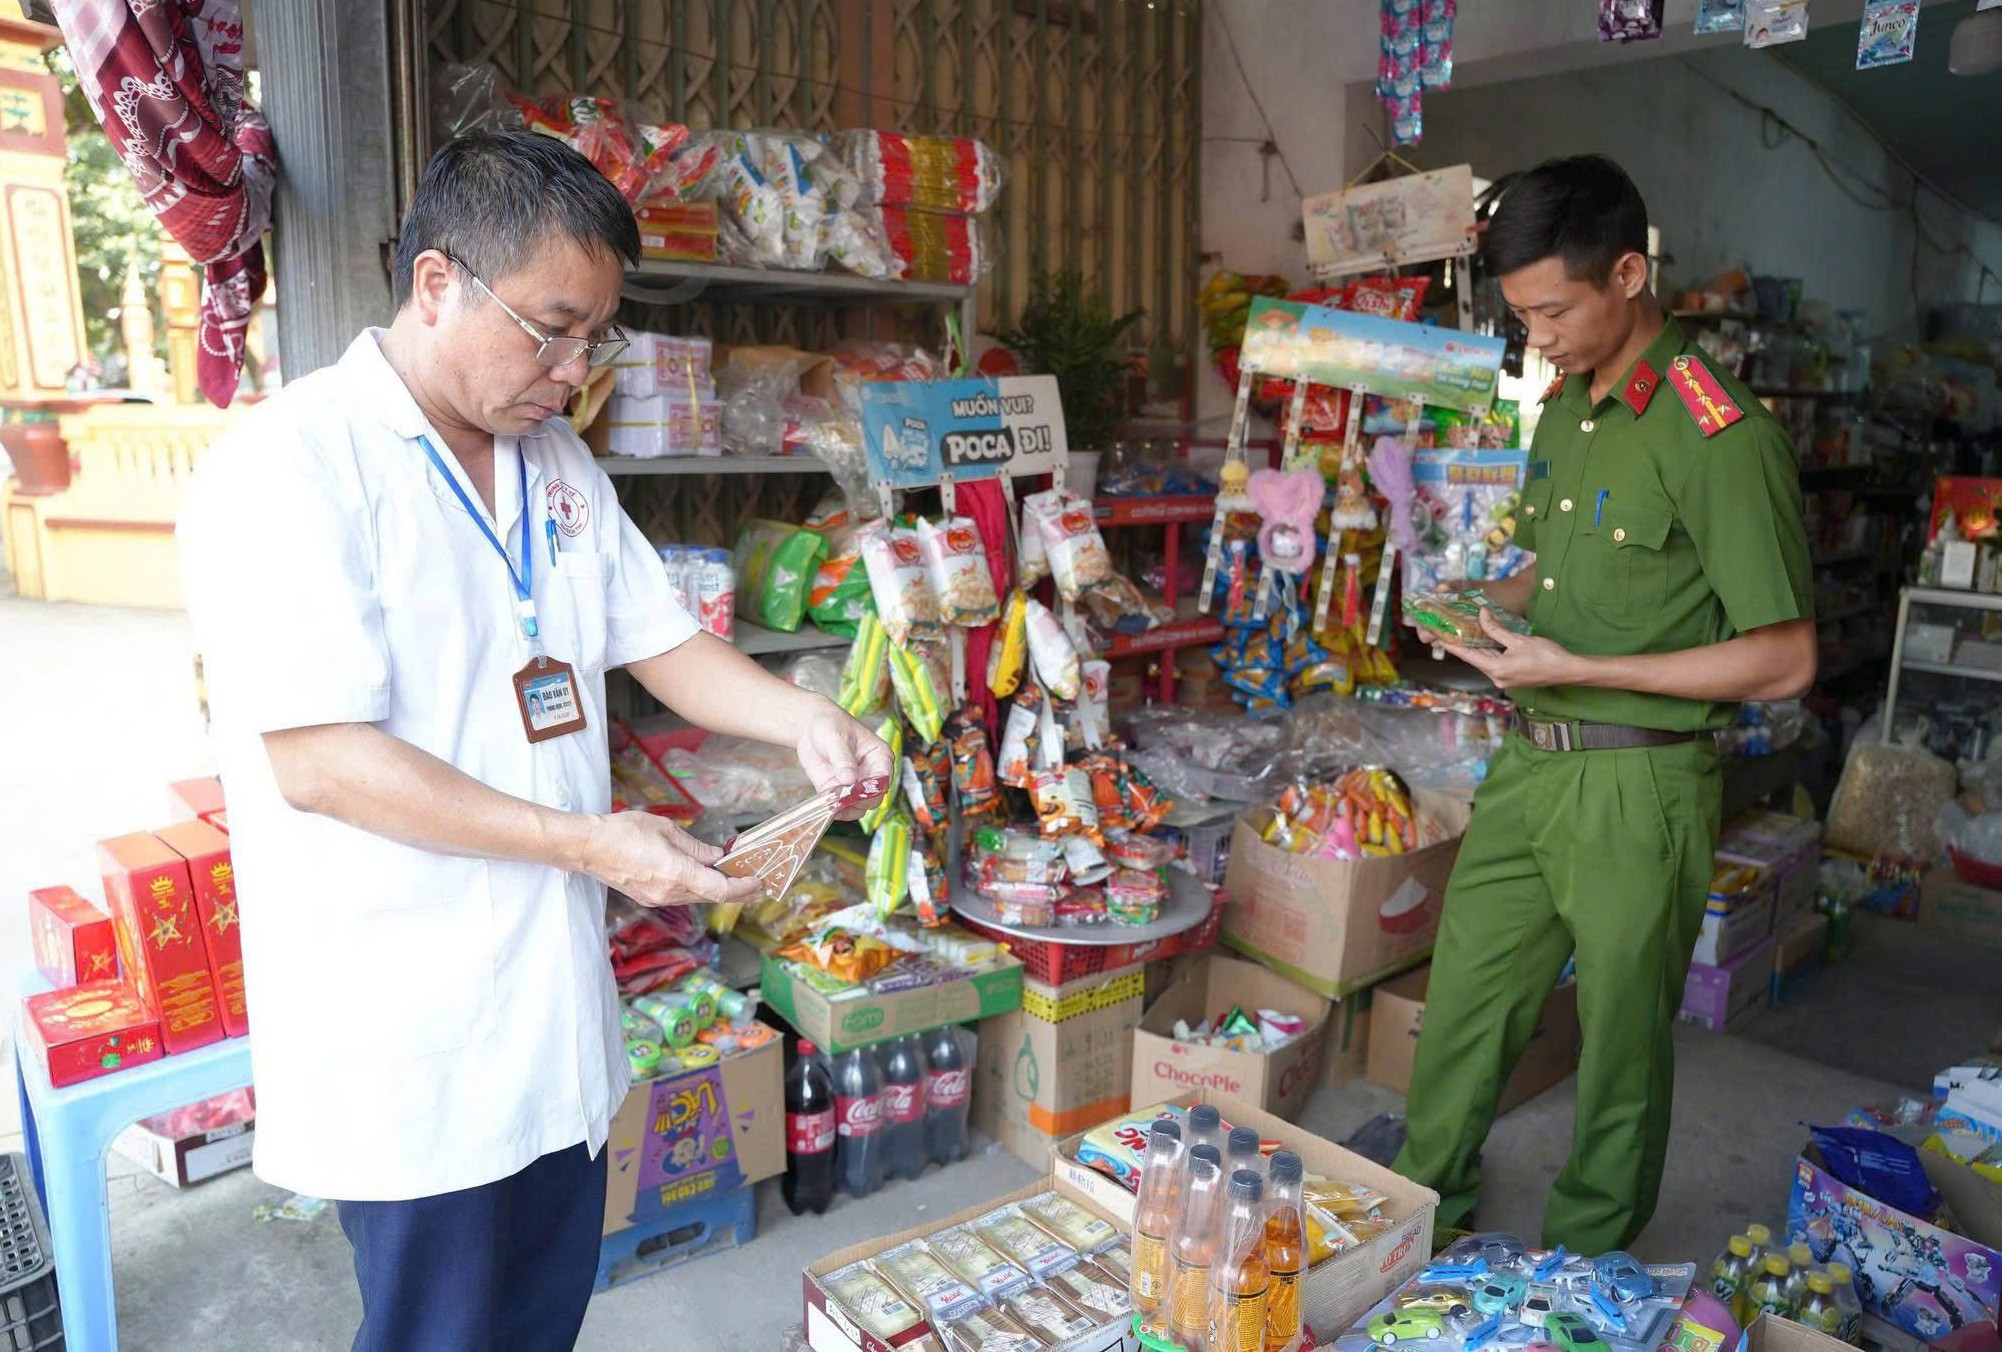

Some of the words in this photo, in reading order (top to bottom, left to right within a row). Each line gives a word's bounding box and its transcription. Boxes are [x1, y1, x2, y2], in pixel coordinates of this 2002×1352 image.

[952, 391, 999, 418] MUỐN
[1001, 394, 1034, 415] VUI?
[945, 432, 1012, 464] POCA
[1018, 425, 1051, 454] ĐI!
